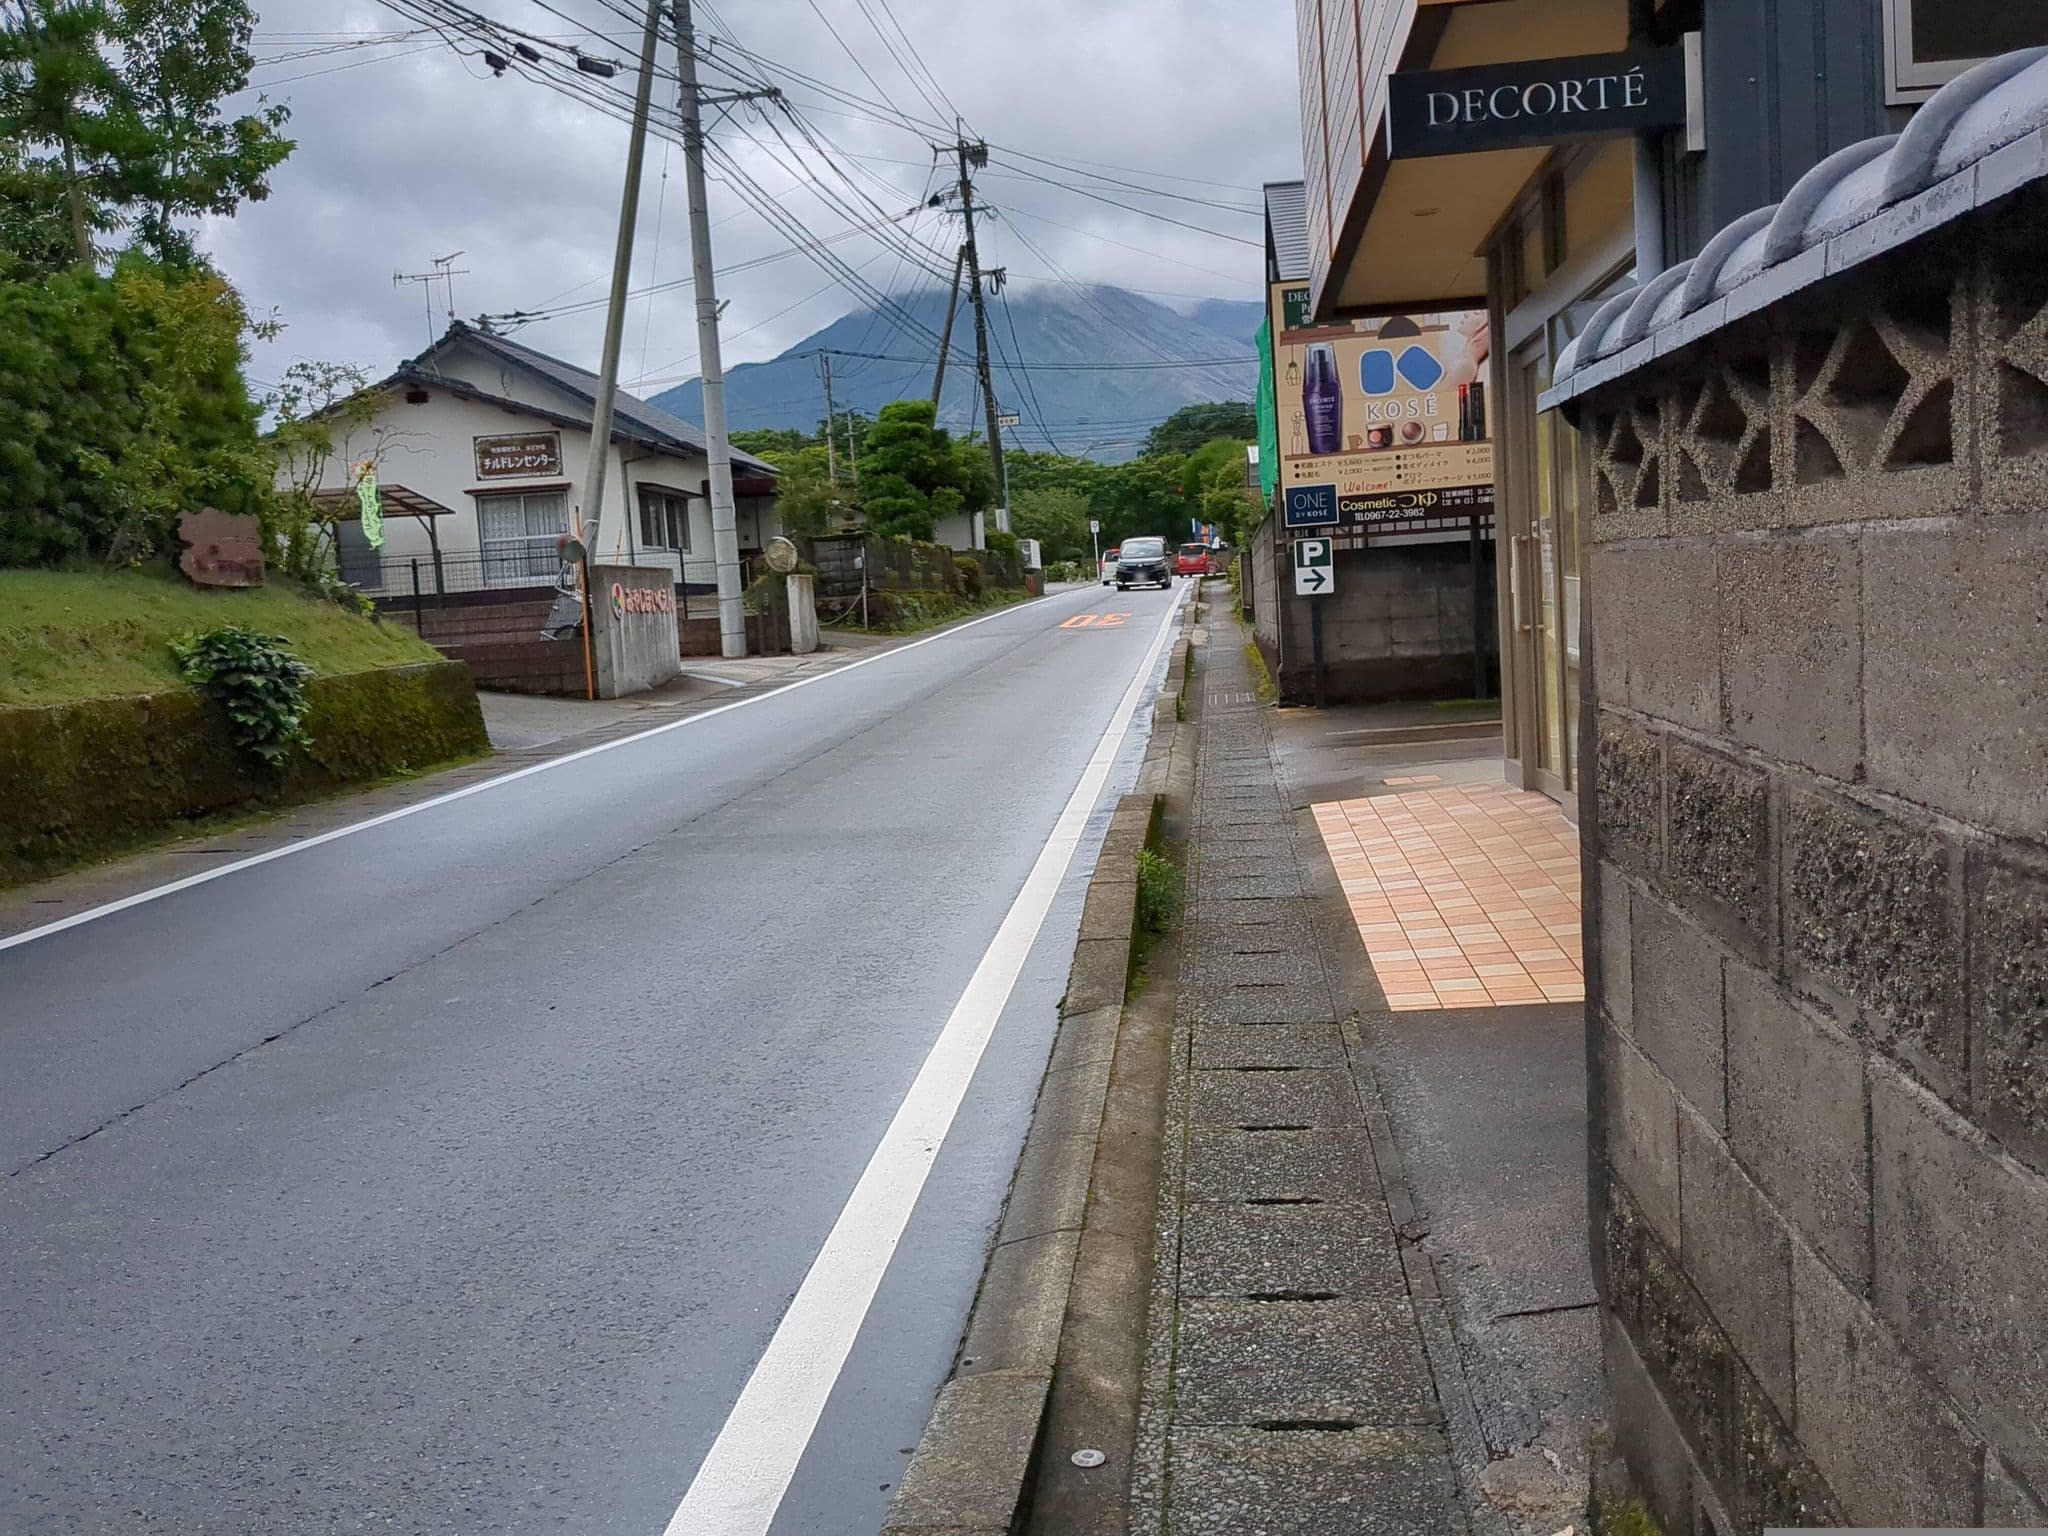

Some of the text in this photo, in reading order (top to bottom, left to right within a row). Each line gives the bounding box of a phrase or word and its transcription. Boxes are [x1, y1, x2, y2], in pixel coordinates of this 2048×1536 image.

[1427, 66, 1648, 126] DECORTÉ
[1366, 394, 1438, 421] KOSÉ
[484, 453, 556, 471] チルドレンセンター
[1344, 480, 1392, 493] Welcome!
[1294, 492, 1328, 509] ONE
[1340, 497, 1397, 512] Cosmetic
[1302, 541, 1324, 565] P
